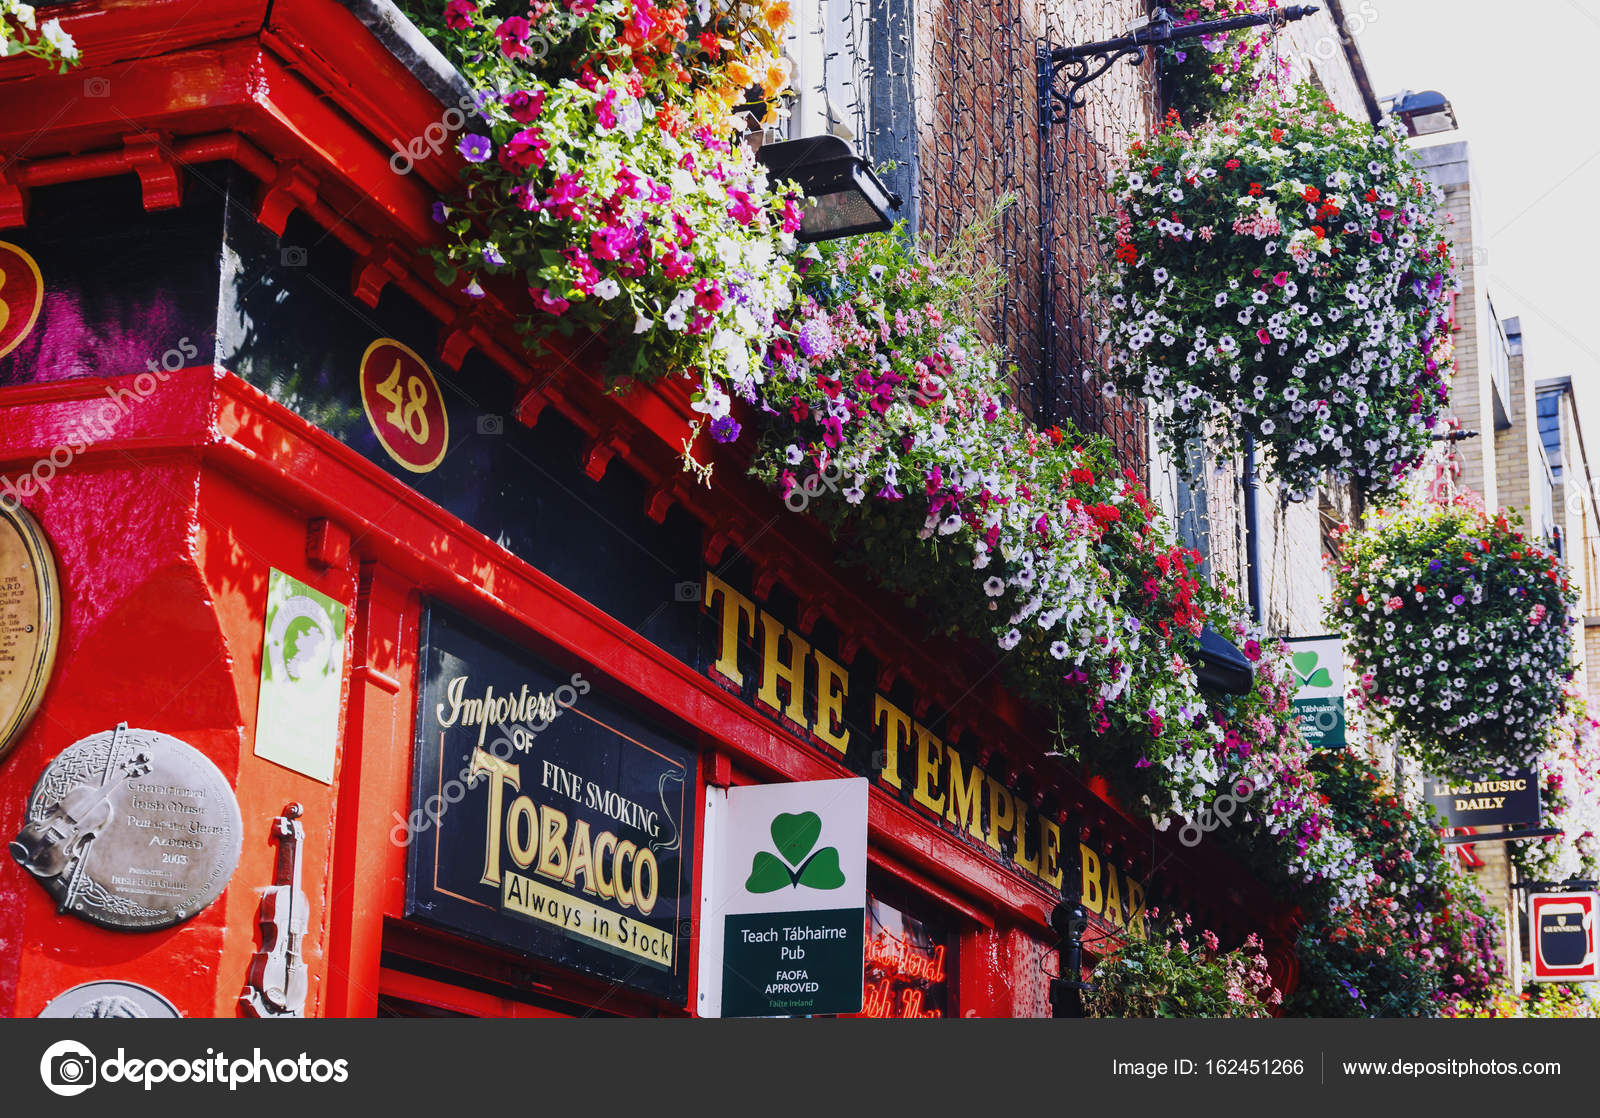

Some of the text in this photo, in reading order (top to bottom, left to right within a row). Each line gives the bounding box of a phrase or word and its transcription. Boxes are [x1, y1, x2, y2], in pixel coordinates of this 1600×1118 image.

[376, 358, 429, 445] 48
[436, 675, 557, 747] Importers
[513, 729, 534, 754] OF
[705, 570, 1148, 940] THE TEMPLE BAR
[1473, 779, 1527, 794] MUSIC
[541, 759, 660, 838] FINE SMOKING
[1455, 797, 1506, 811] DAILY
[467, 745, 659, 917] TOBACCO
[162, 853, 189, 865] 2003
[508, 874, 669, 960] Always in Stock
[741, 925, 847, 943] Teach Tábhairne
[781, 945, 806, 960] Pub
[776, 970, 809, 981] FAOFA
[765, 982, 819, 994] APPROVED
